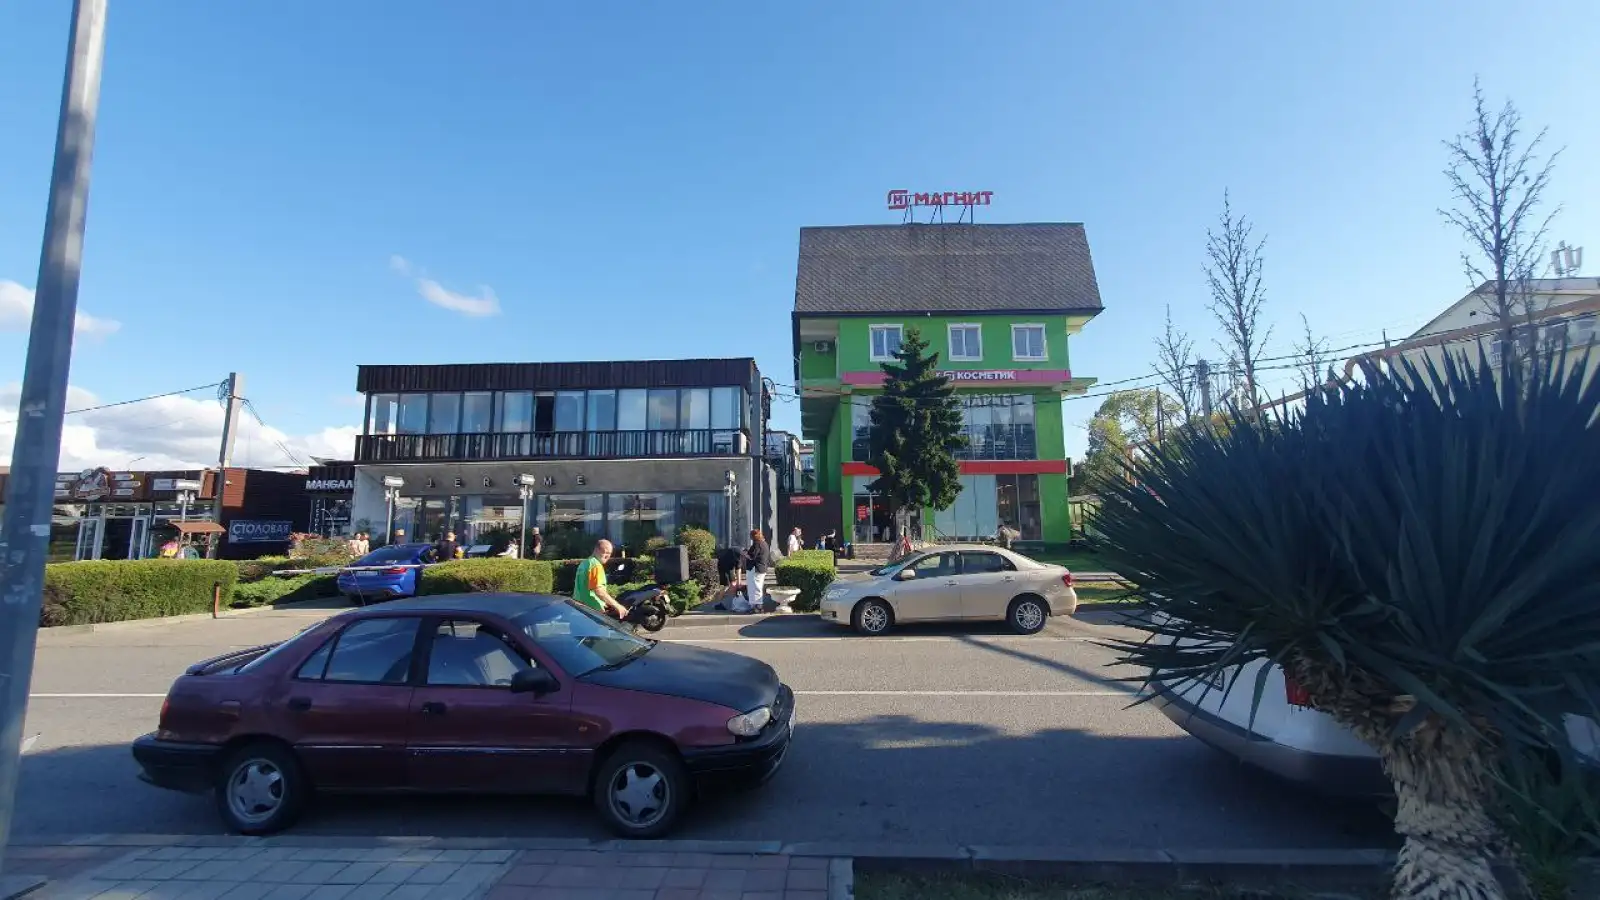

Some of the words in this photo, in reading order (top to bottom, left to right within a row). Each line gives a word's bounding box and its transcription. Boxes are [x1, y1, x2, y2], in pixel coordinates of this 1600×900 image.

[914, 191, 994, 206] МАГНИТ
[957, 371, 1016, 380] КОСМЕТИК
[233, 524, 289, 535] СТОЛОВАЯ
